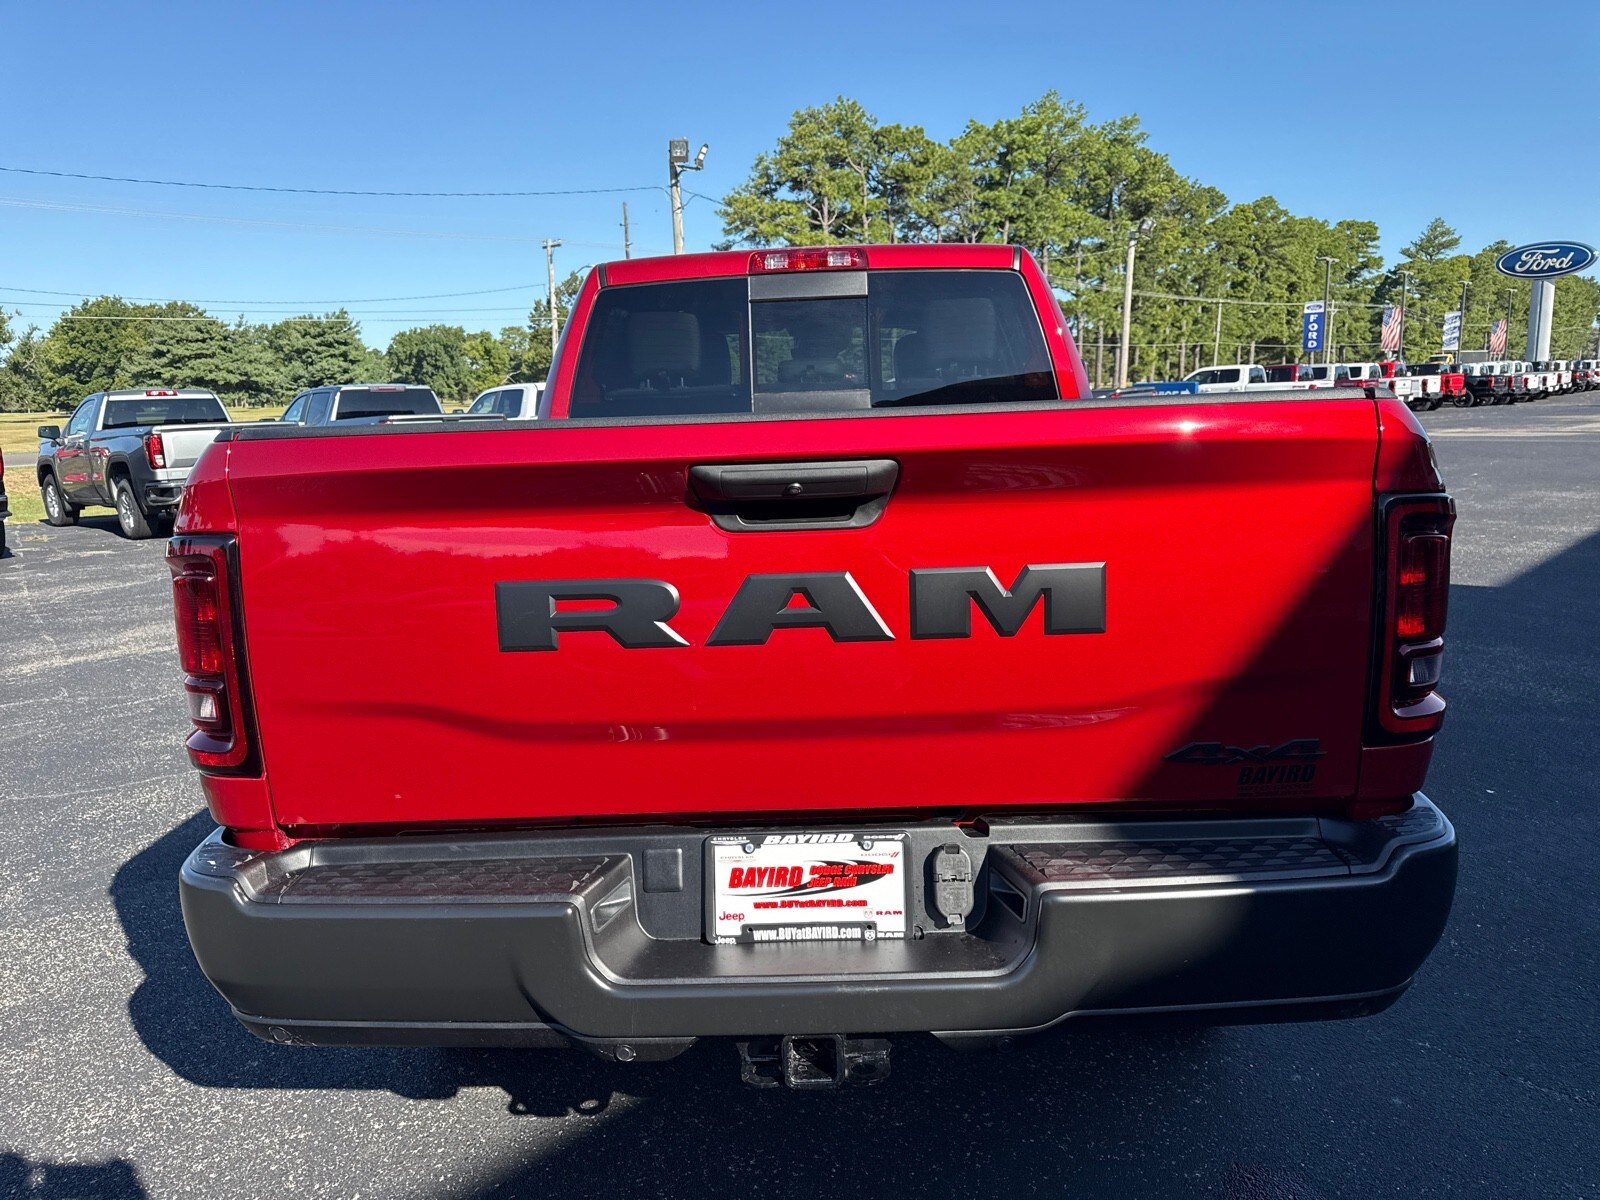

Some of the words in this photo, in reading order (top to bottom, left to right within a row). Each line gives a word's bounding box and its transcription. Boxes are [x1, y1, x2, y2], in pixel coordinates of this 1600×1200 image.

[1513, 248, 1573, 272] Ford
[1307, 314, 1319, 349] FORD
[494, 561, 1107, 652] RAM
[1237, 765, 1316, 785] BAYIRD
[763, 834, 855, 846] BAYIRD
[809, 865, 844, 876] DODGE
[844, 863, 895, 876] CHRYSLER
[728, 866, 803, 888] BAYIRD
[806, 877, 833, 889] JEEP
[833, 876, 858, 888] RAM
[719, 910, 745, 922] Jeep
[714, 935, 737, 945] Jeep
[753, 926, 862, 941] www.BUYatBAYIRD.com
[876, 930, 905, 938] RAM
